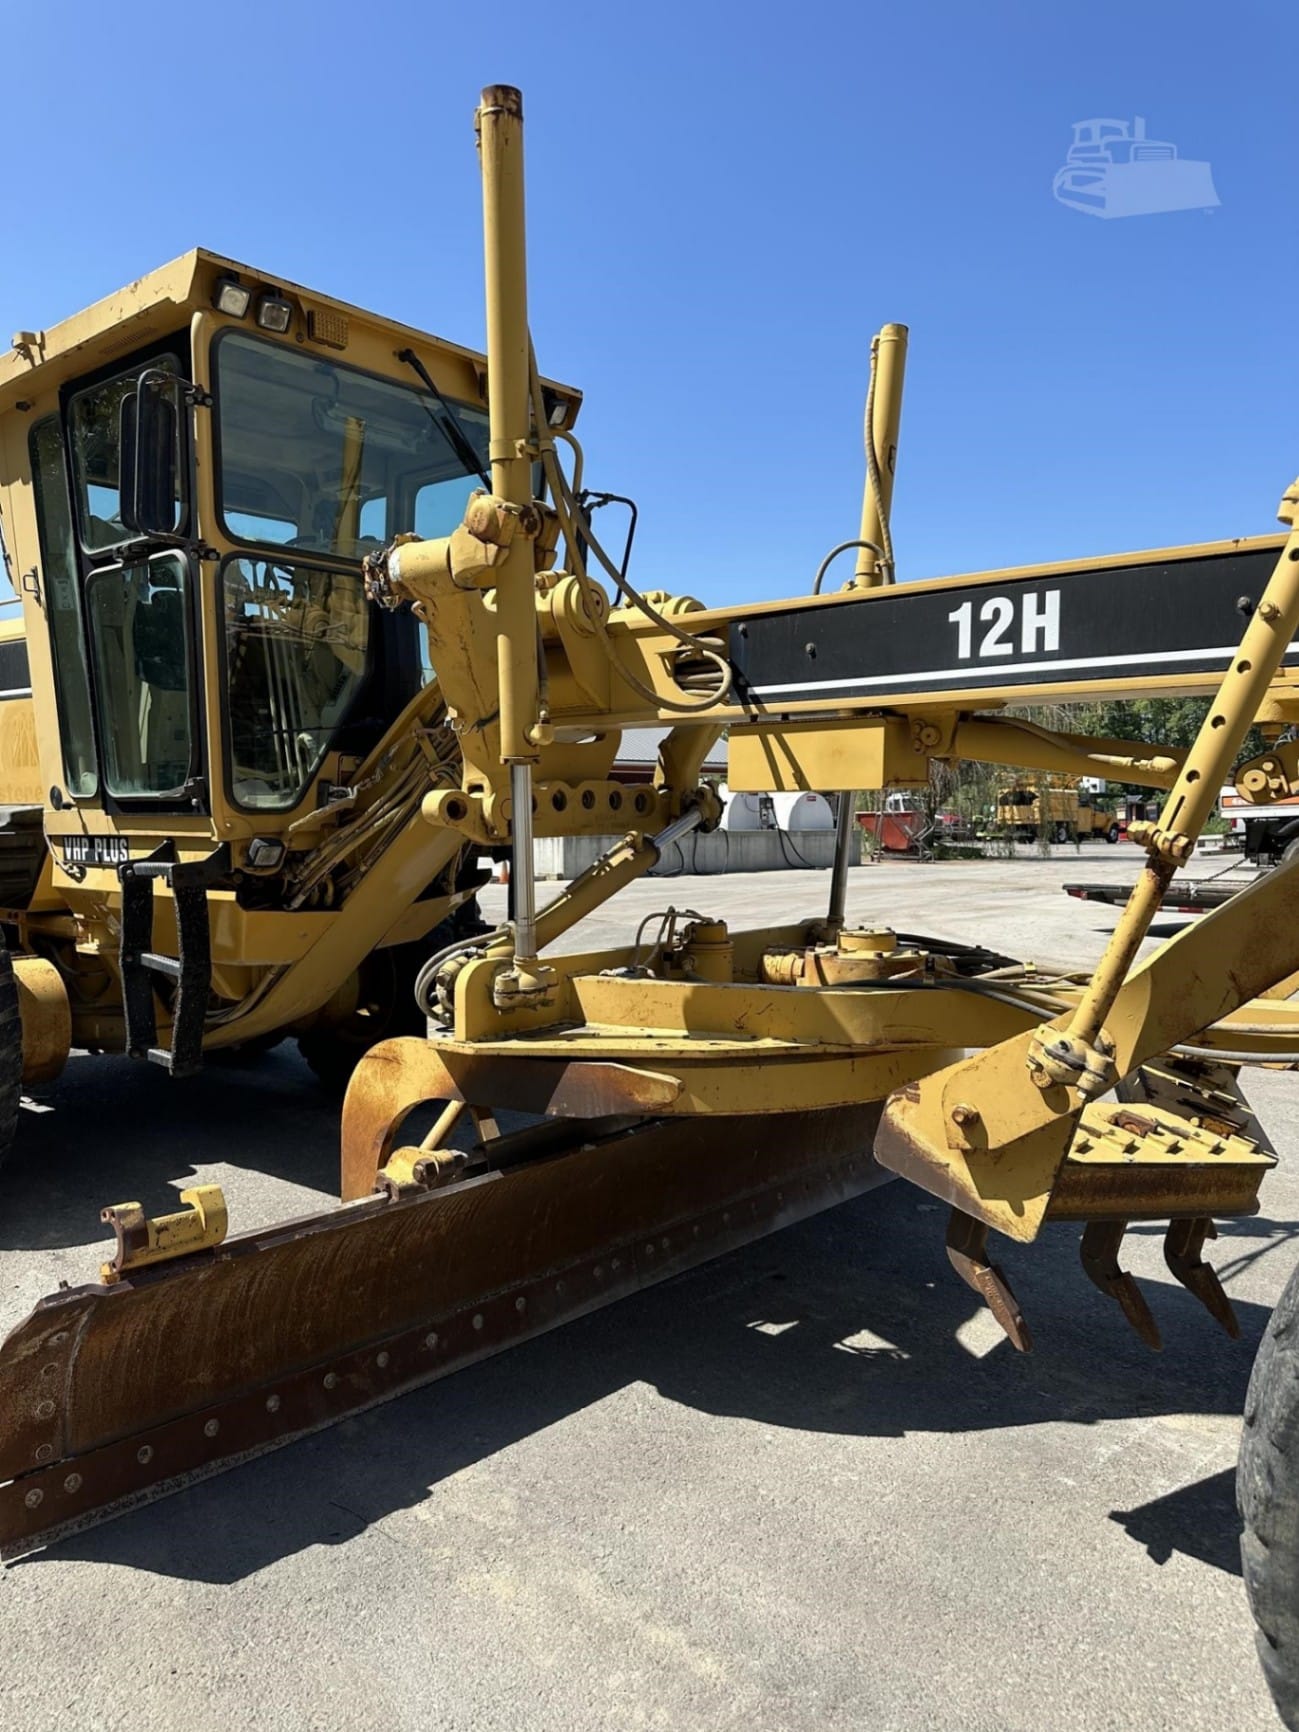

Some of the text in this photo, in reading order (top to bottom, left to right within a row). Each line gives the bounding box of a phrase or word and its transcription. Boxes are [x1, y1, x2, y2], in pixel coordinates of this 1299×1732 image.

[948, 589, 1061, 659] 12H
[64, 836, 128, 863] VHP PLUS
